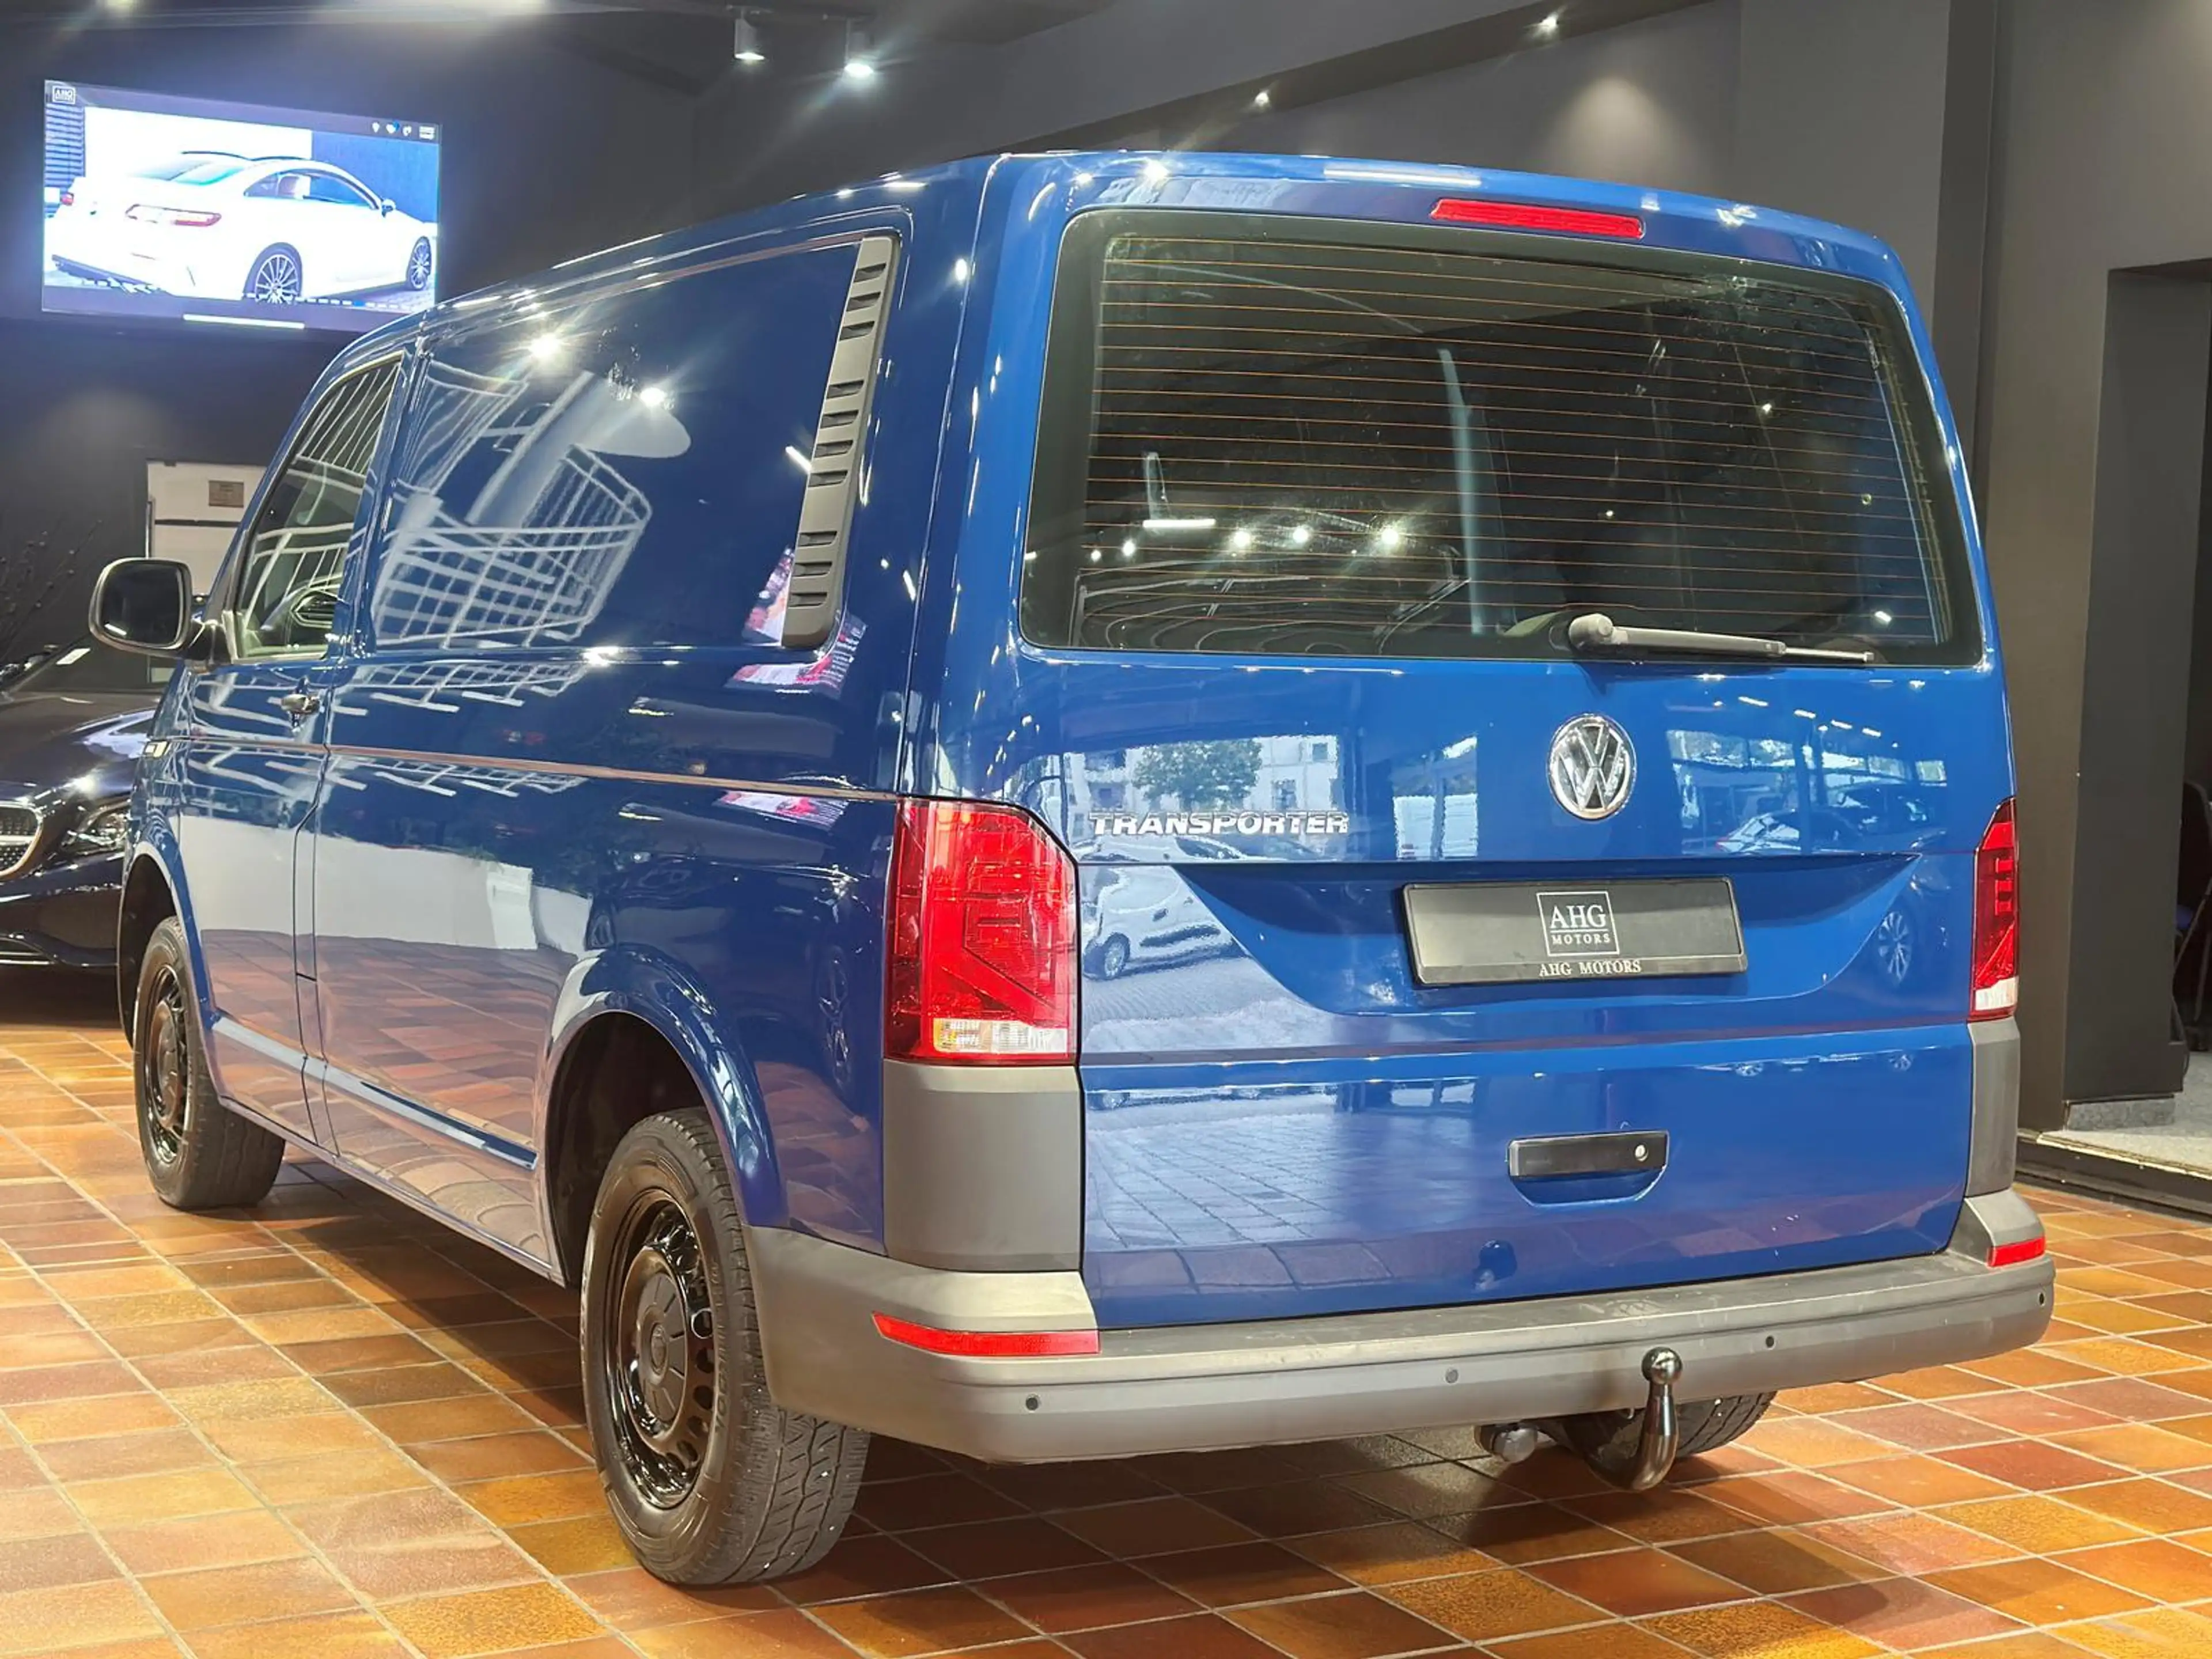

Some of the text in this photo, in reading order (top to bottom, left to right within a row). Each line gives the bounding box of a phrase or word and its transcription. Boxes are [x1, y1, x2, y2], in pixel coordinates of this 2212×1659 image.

[1552, 717, 1631, 813] VW
[1089, 811, 1349, 835] TRANSPORTER
[1549, 904, 1607, 929] AHG
[1551, 933, 1611, 945] MOTORS
[1539, 959, 1642, 977] AHG MOTORS
